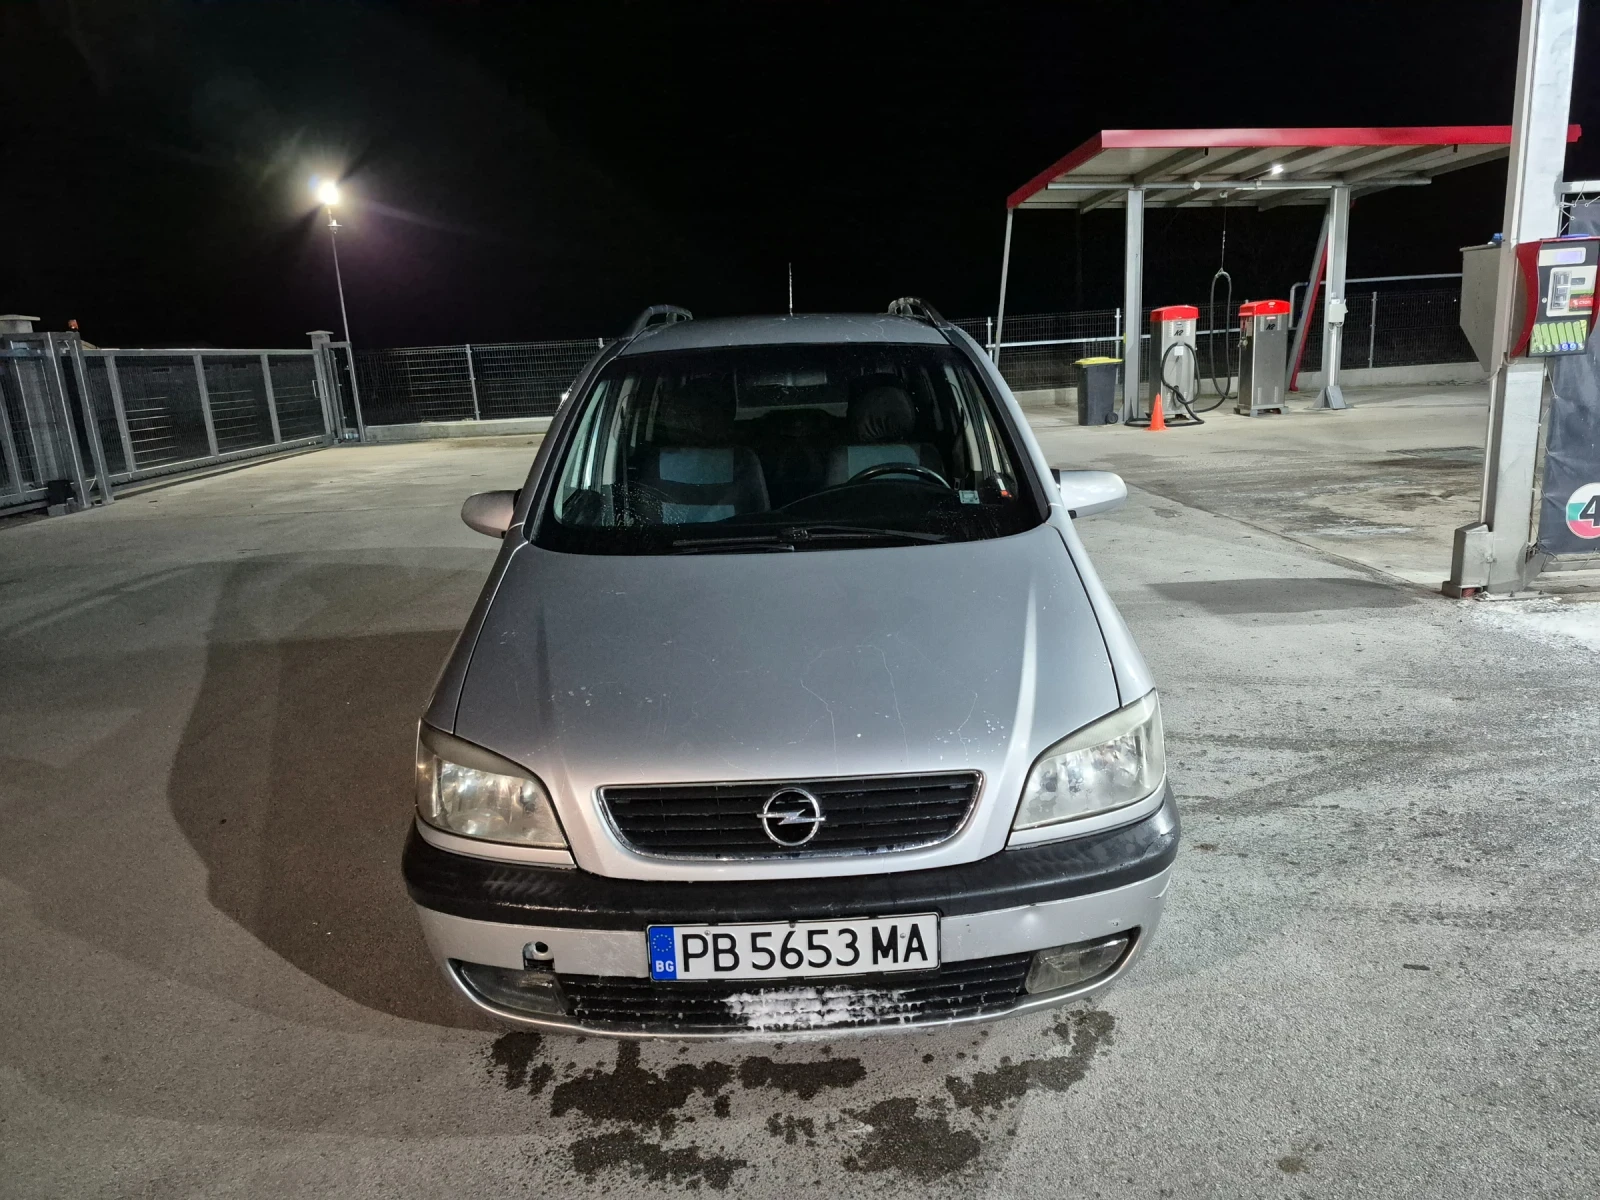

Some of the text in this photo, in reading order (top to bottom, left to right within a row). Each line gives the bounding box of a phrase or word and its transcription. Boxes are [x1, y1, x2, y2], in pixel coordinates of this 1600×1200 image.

[1579, 495, 1600, 527] 4
[681, 923, 929, 972] PB 5653 MA
[655, 960, 675, 973] BG
